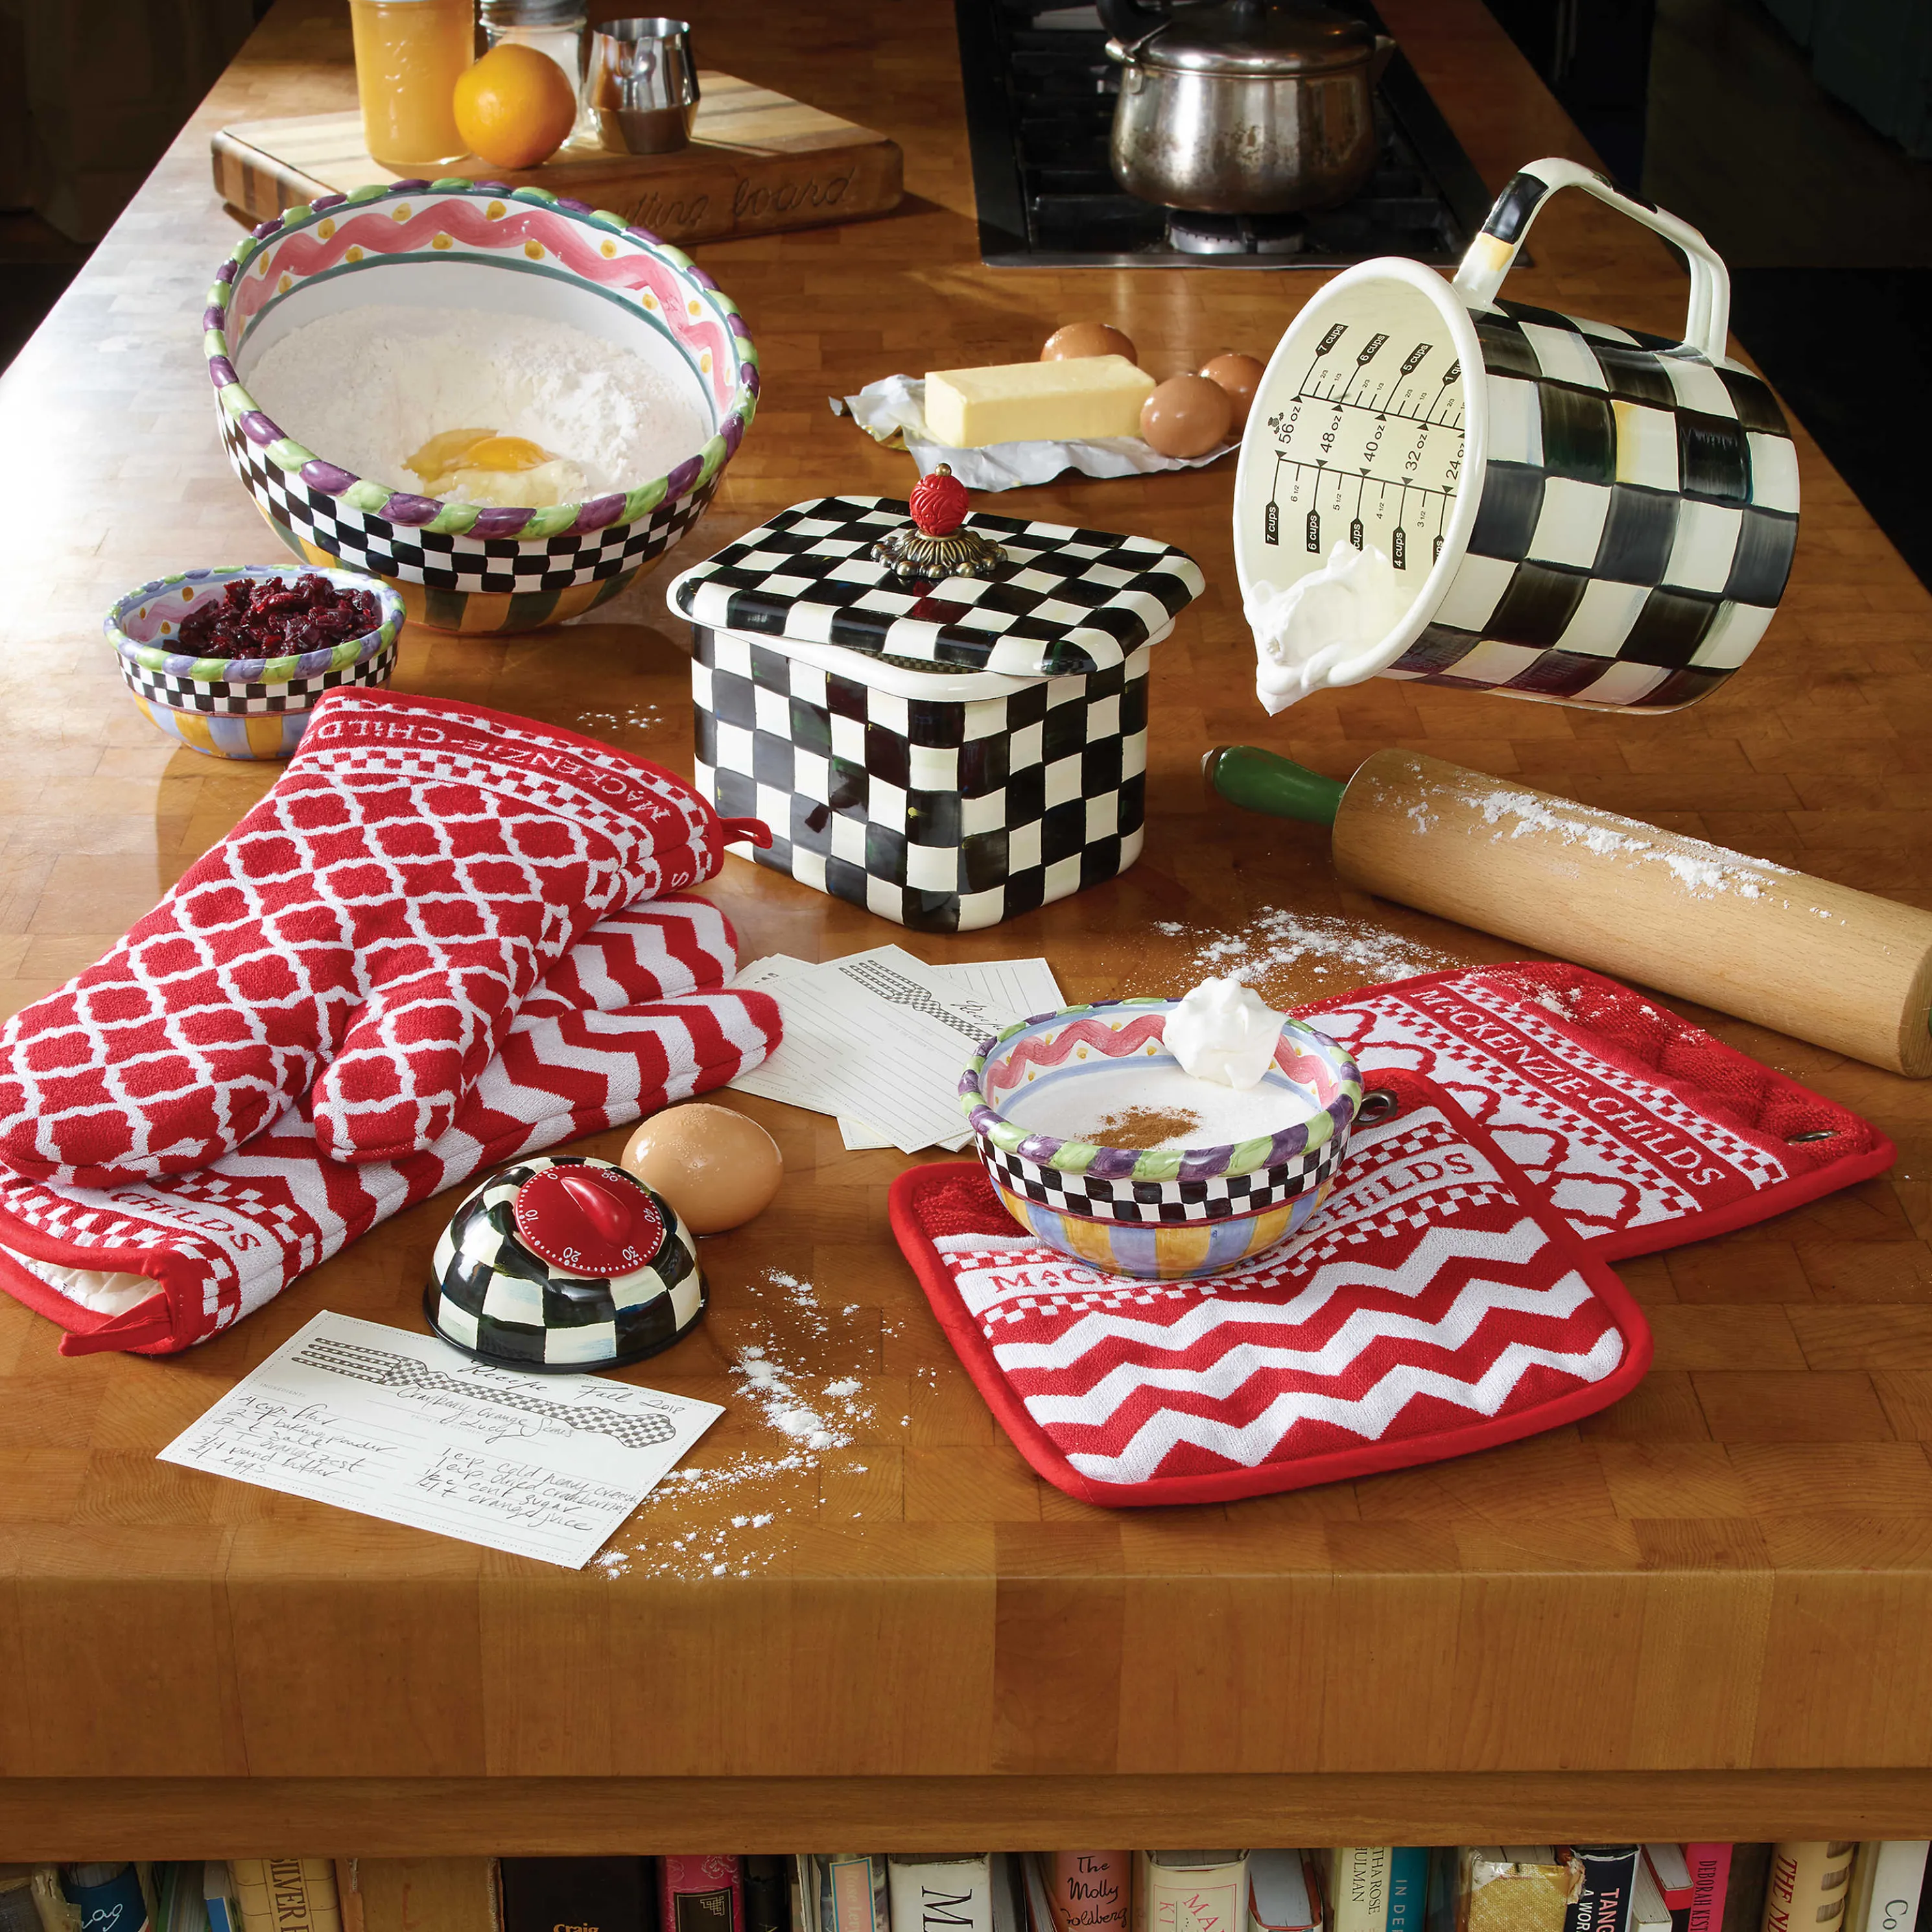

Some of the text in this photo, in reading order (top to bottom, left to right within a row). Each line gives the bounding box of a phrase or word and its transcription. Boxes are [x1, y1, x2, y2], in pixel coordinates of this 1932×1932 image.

[616, 167, 855, 227] utting board
[1325, 325, 1344, 344] cups
[1367, 335, 1385, 354] cups
[1410, 344, 1429, 364] cups
[1320, 370, 1328, 379] 2/3
[1362, 379, 1371, 388] 2/3
[1376, 383, 1385, 391] 1/3
[1404, 389, 1413, 398] 2/3
[1419, 392, 1428, 401] 1/3
[1446, 398, 1455, 407] 2/3
[1278, 406, 1301, 444] 56 oz
[1320, 415, 1342, 453] 48 oz
[1363, 425, 1385, 462] 40 oz
[1405, 434, 1428, 471] 32 oz
[1445, 460, 1461, 480] 24
[1268, 506, 1278, 532] cups
[1309, 515, 1319, 541] cups
[1395, 532, 1404, 558] cups
[547, 1172, 559, 1181] 0
[600, 1171, 619, 1183] 50
[524, 1209, 539, 1221] 10
[643, 1207, 656, 1223] 40
[563, 1247, 582, 1263] 20
[622, 1245, 639, 1261] 30
[457, 1360, 550, 1393] Recipe
[639, 1399, 687, 1415] 2018
[1077, 1855, 1111, 1874] The
[1368, 1847, 1385, 1915] THA ROSE
[1395, 1879, 1408, 1896] IN
[1693, 1859, 1717, 1907] DEBORAH
[1772, 1854, 1798, 1903] THE
[270, 1859, 307, 1922] ILVER
[1067, 1877, 1119, 1905] Molly
